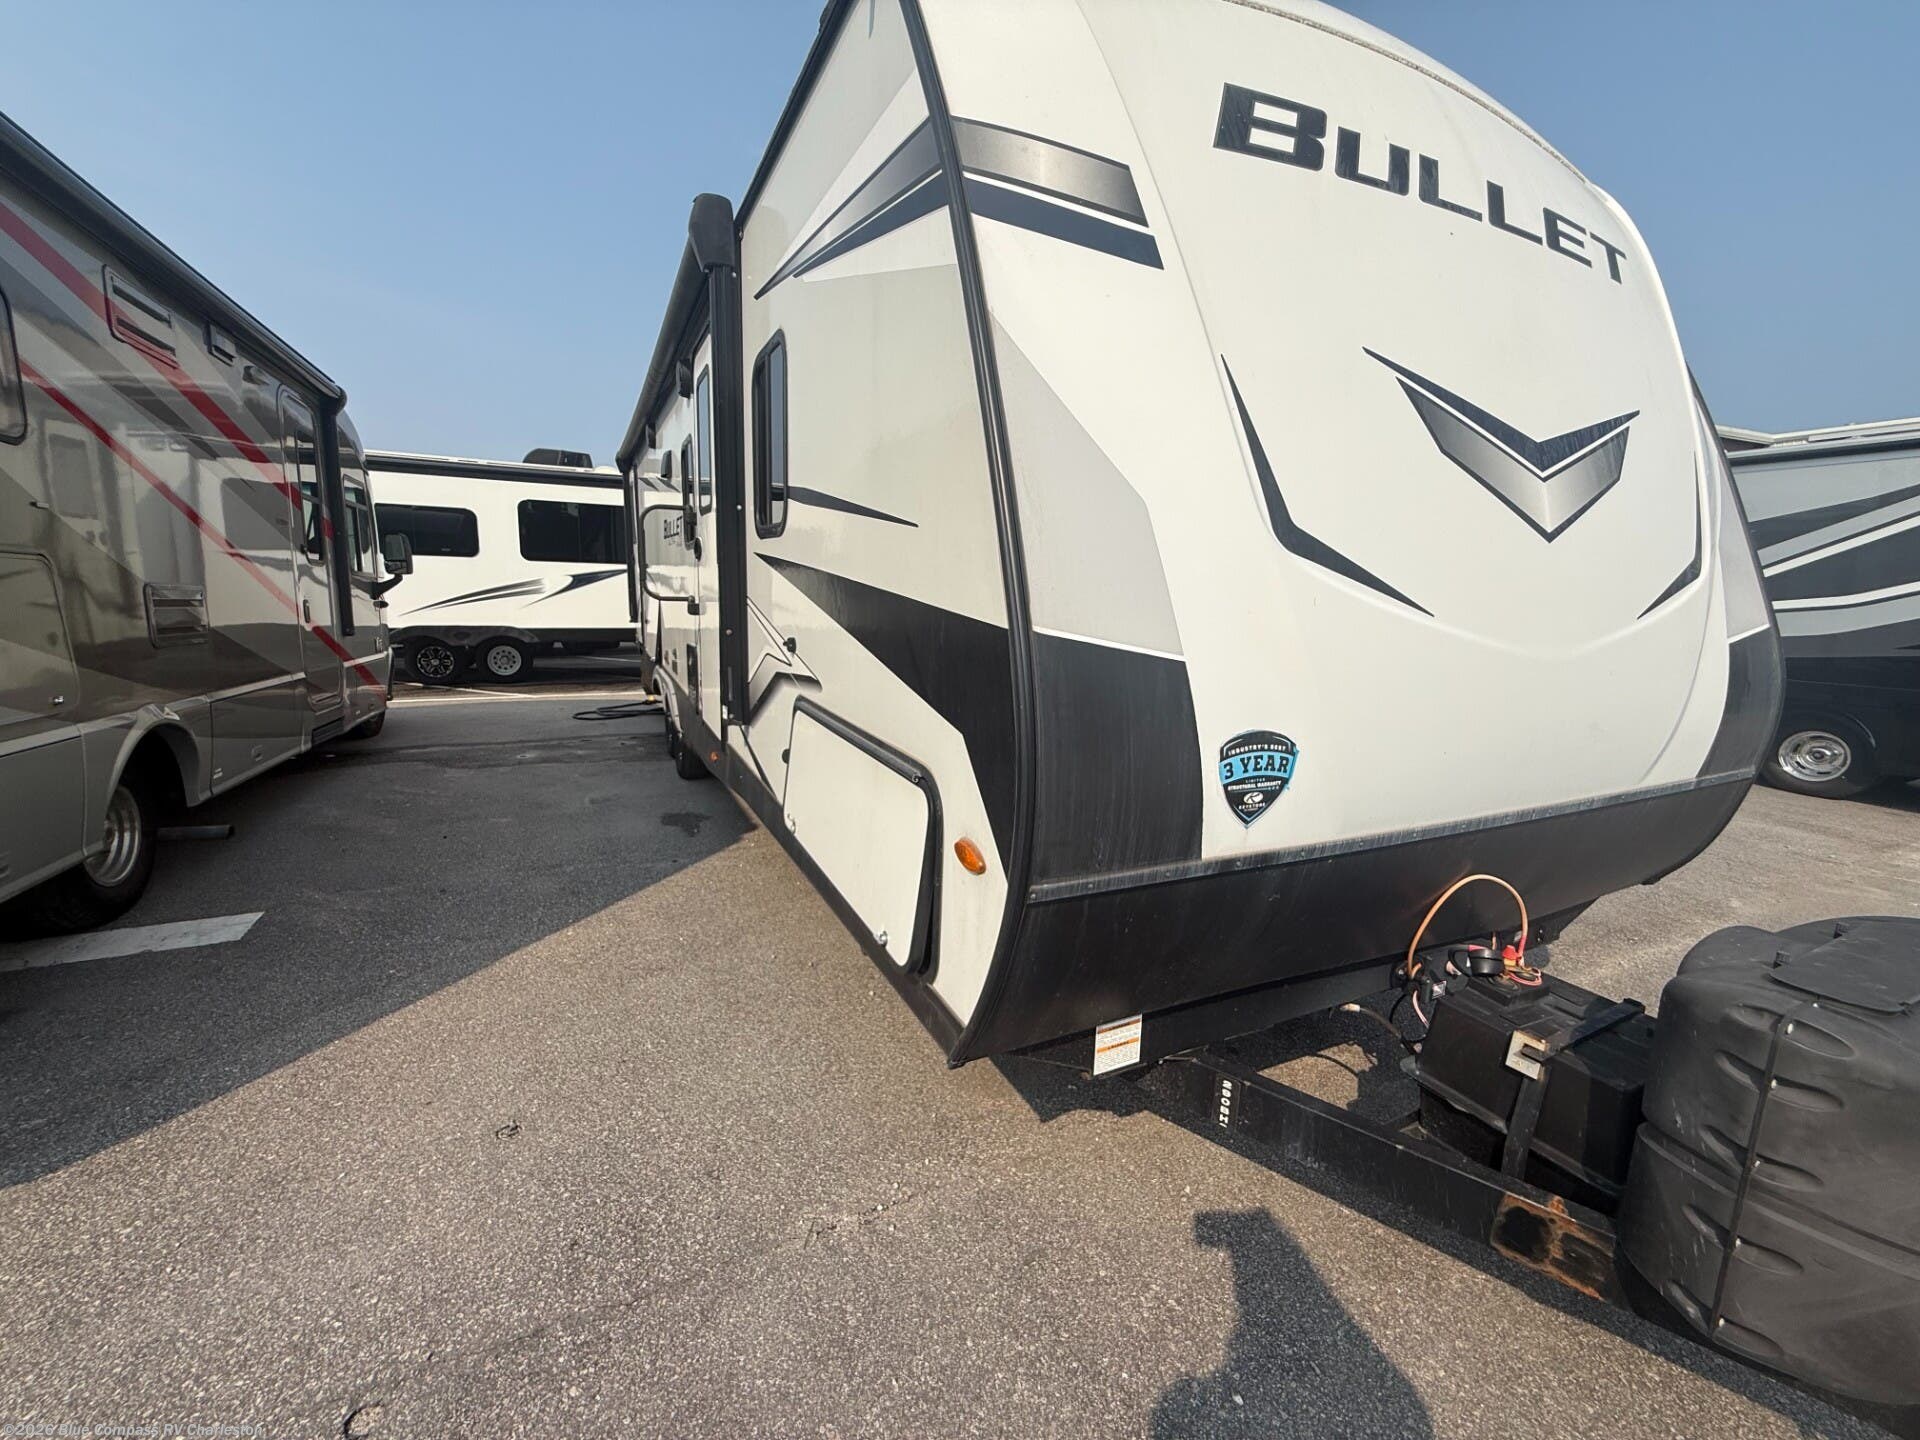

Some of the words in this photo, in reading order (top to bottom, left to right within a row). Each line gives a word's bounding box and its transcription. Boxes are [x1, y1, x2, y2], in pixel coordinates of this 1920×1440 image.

[1213, 82, 1627, 285] BULLET
[1228, 744, 1268, 755] INDUSTRY'S
[1223, 761, 1234, 780] 3
[1239, 754, 1290, 774] YEAR
